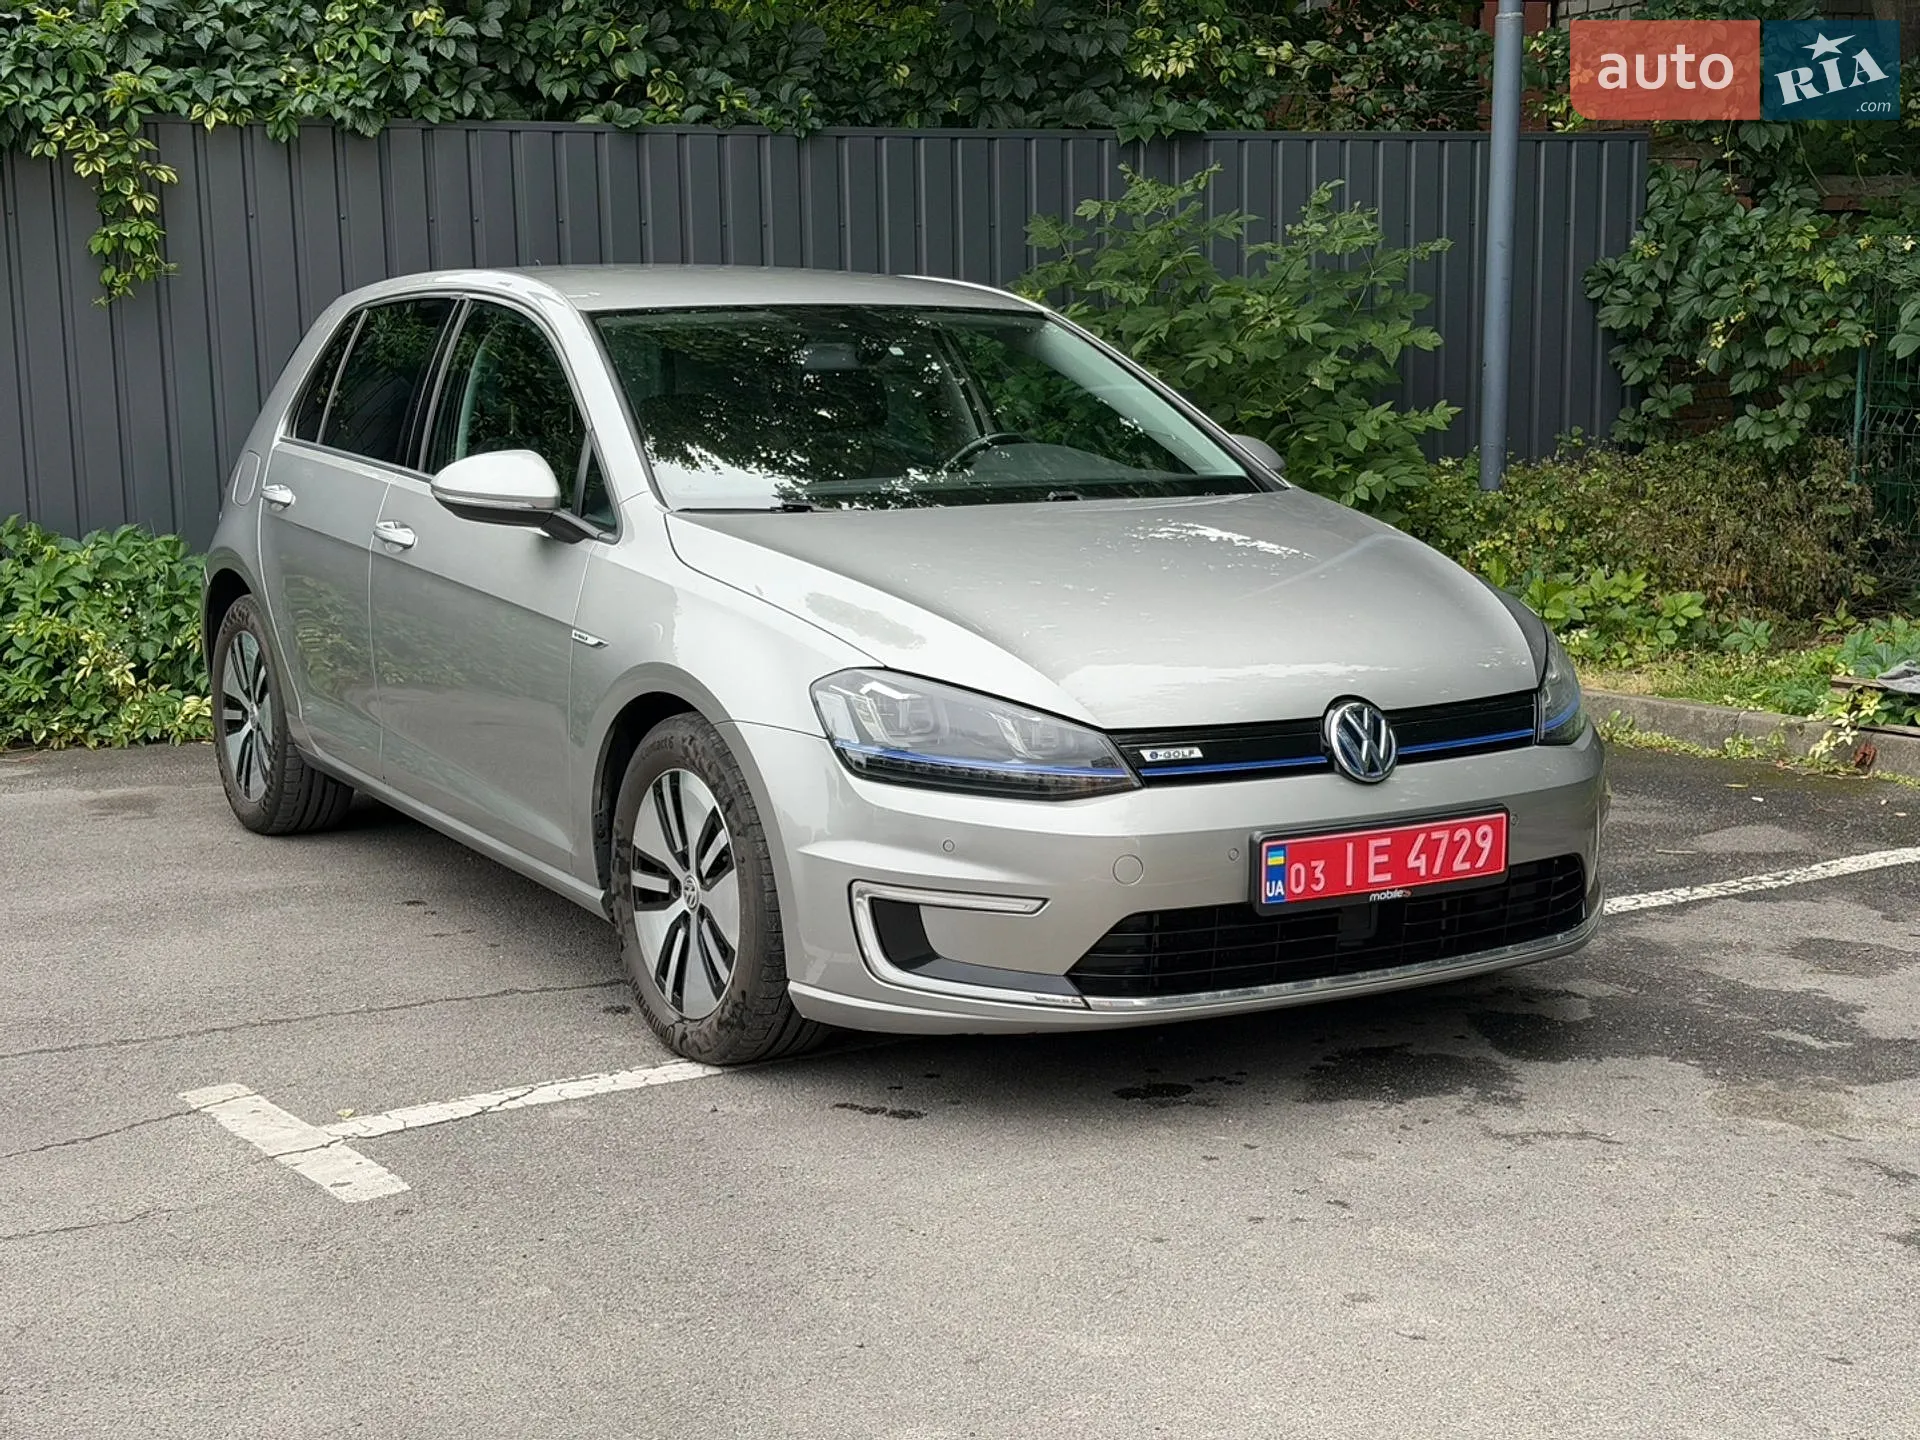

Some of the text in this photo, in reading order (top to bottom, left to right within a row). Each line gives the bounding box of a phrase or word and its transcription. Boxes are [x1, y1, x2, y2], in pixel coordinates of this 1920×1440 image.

[1289, 824, 1494, 894] 03 IE 4729
[1266, 880, 1285, 897] UA
